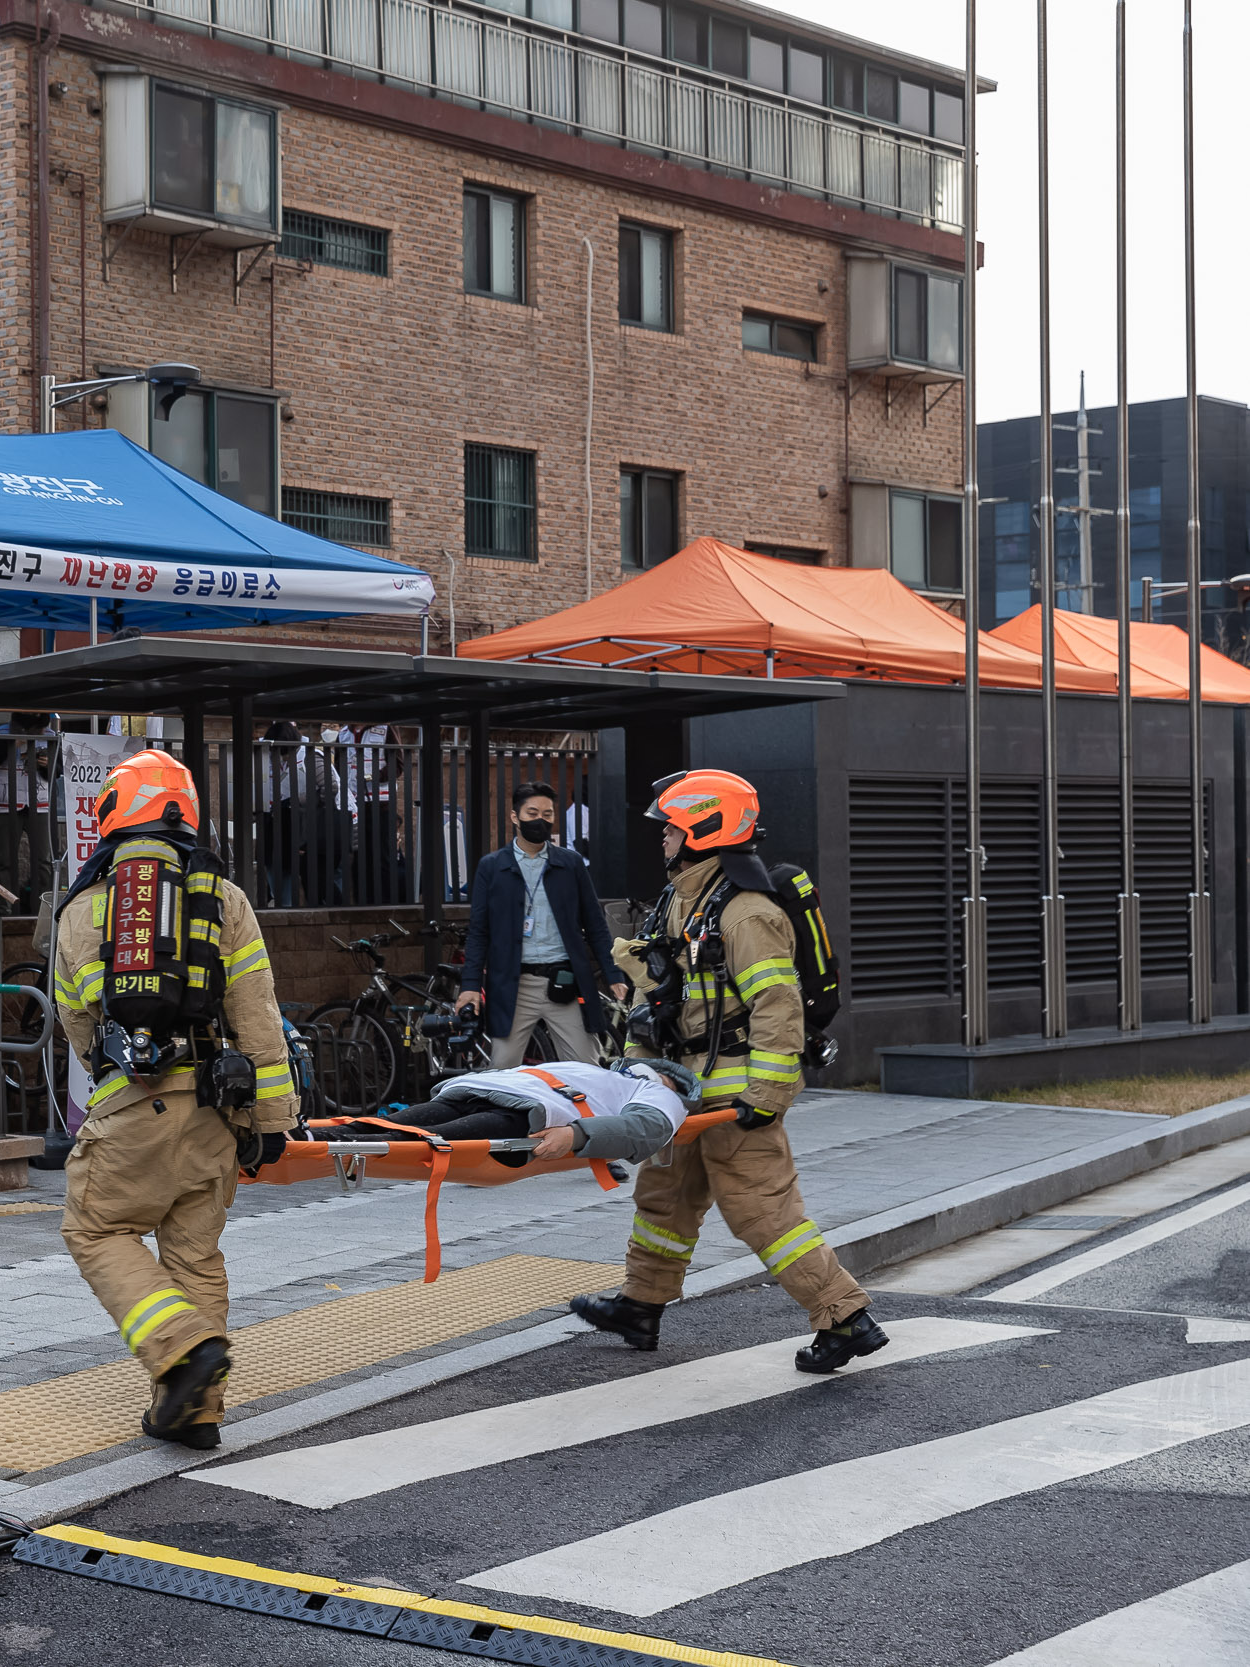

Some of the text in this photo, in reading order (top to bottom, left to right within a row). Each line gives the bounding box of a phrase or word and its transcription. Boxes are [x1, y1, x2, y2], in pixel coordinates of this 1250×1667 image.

[2, 486, 124, 506] GWANGJIN-GU
[59, 556, 158, 593] 재난현장
[172, 567, 282, 601] 응급의료소
[71, 765, 101, 783] 2022
[75, 796, 100, 879] 재난대
[117, 864, 134, 966] 119구조대
[134, 863, 154, 966] 광진소방서
[115, 975, 161, 994] 안기태
